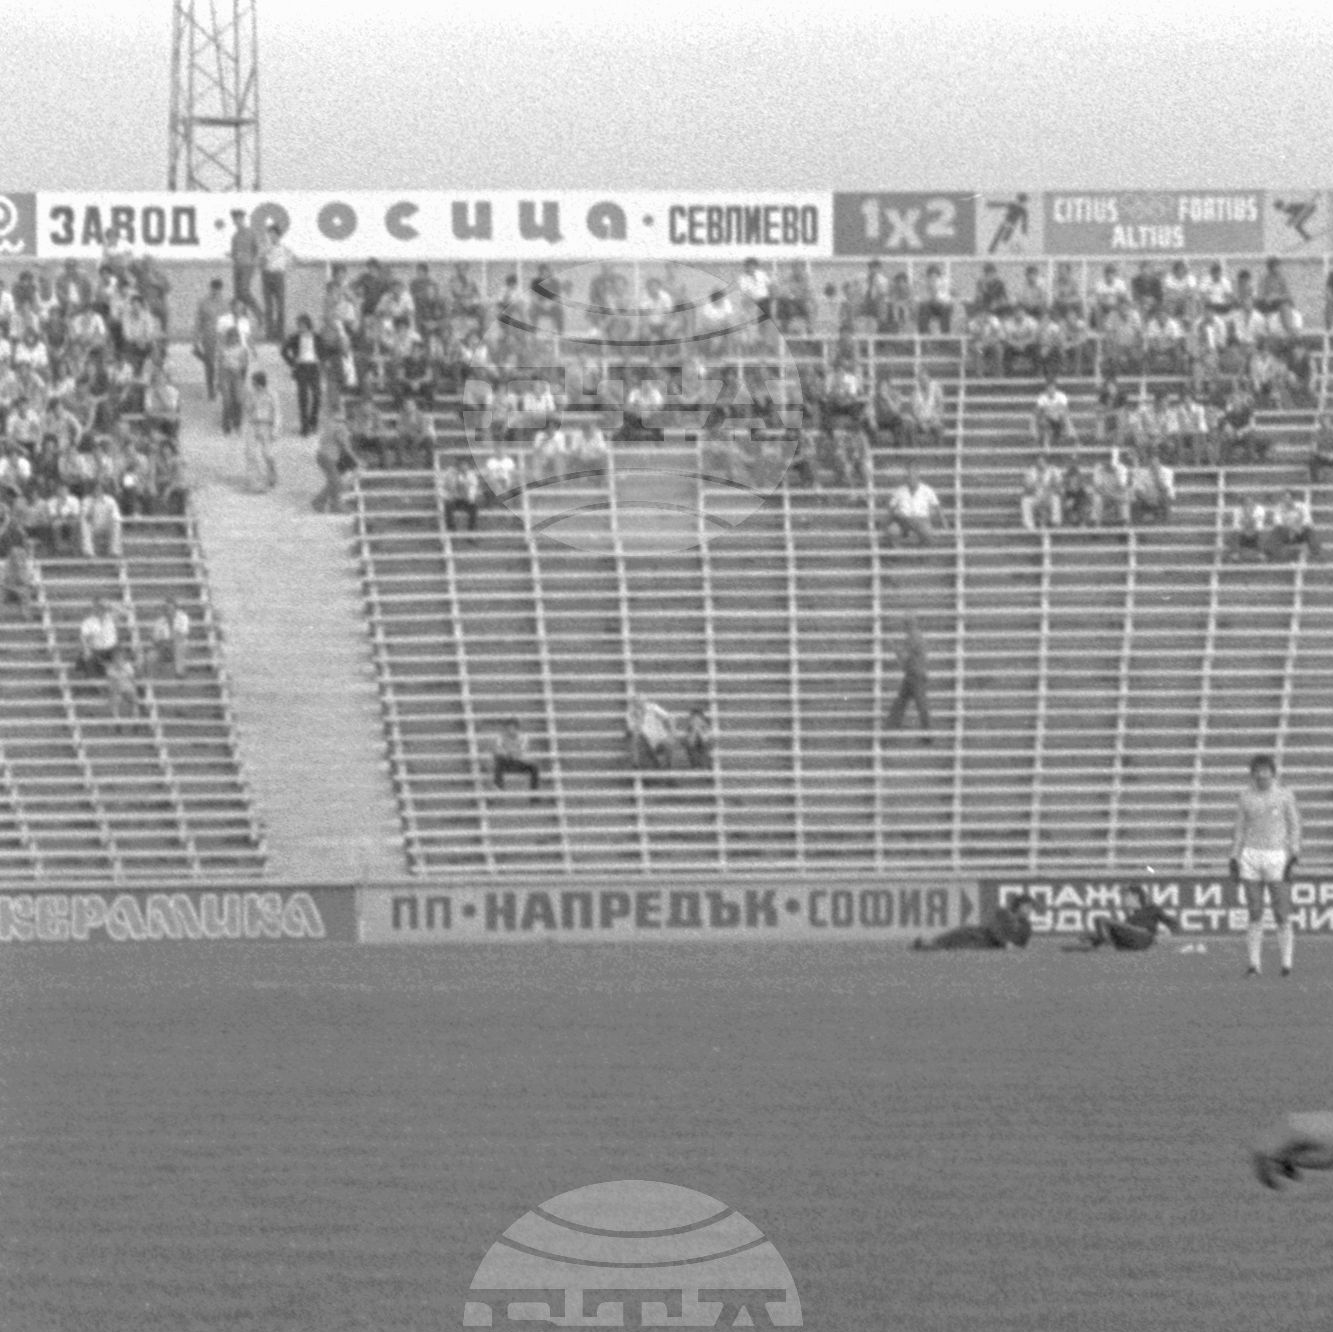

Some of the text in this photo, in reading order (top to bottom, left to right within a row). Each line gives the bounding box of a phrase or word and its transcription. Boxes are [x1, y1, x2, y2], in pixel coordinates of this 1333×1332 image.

[49, 205, 199, 246] ЗАВОД
[669, 203, 820, 246] СЕВЛИЕВО
[1111, 223, 1185, 250] ALTIUS
[392, 888, 949, 932] ПП НАПРЕДЪК СОФИЯ
[998, 884, 1179, 909] ПЛАЖИ
[1194, 883, 1222, 908] И
